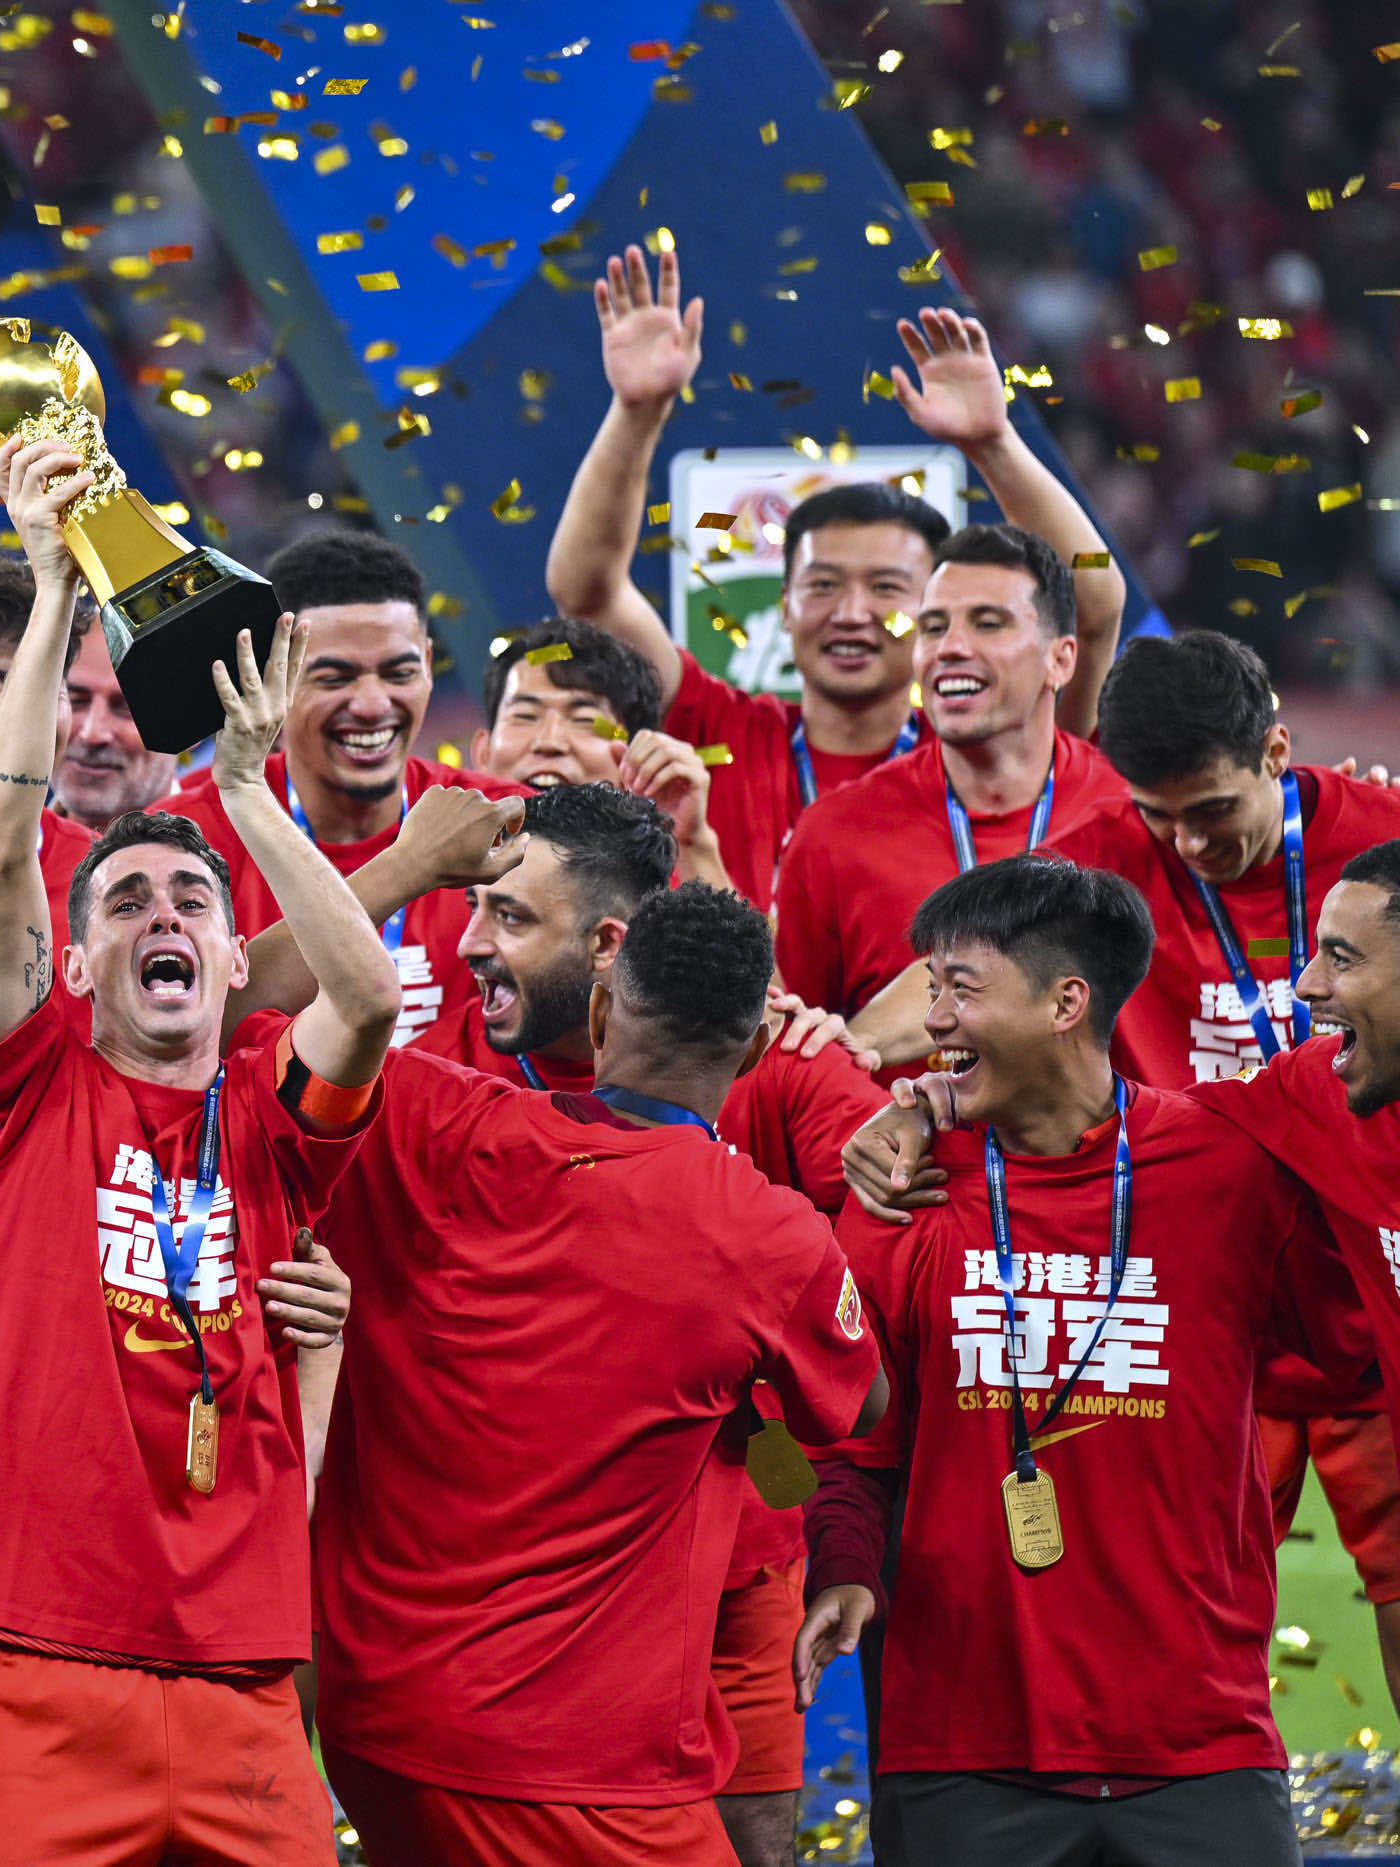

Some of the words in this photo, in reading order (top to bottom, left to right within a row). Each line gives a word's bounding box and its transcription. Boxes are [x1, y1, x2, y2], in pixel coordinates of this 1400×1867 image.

[963, 1249, 1158, 1298] 海港是
[104, 1289, 154, 1319] 2024
[950, 1295, 1170, 1393] 冠军
[985, 1390, 1038, 1412] 204
